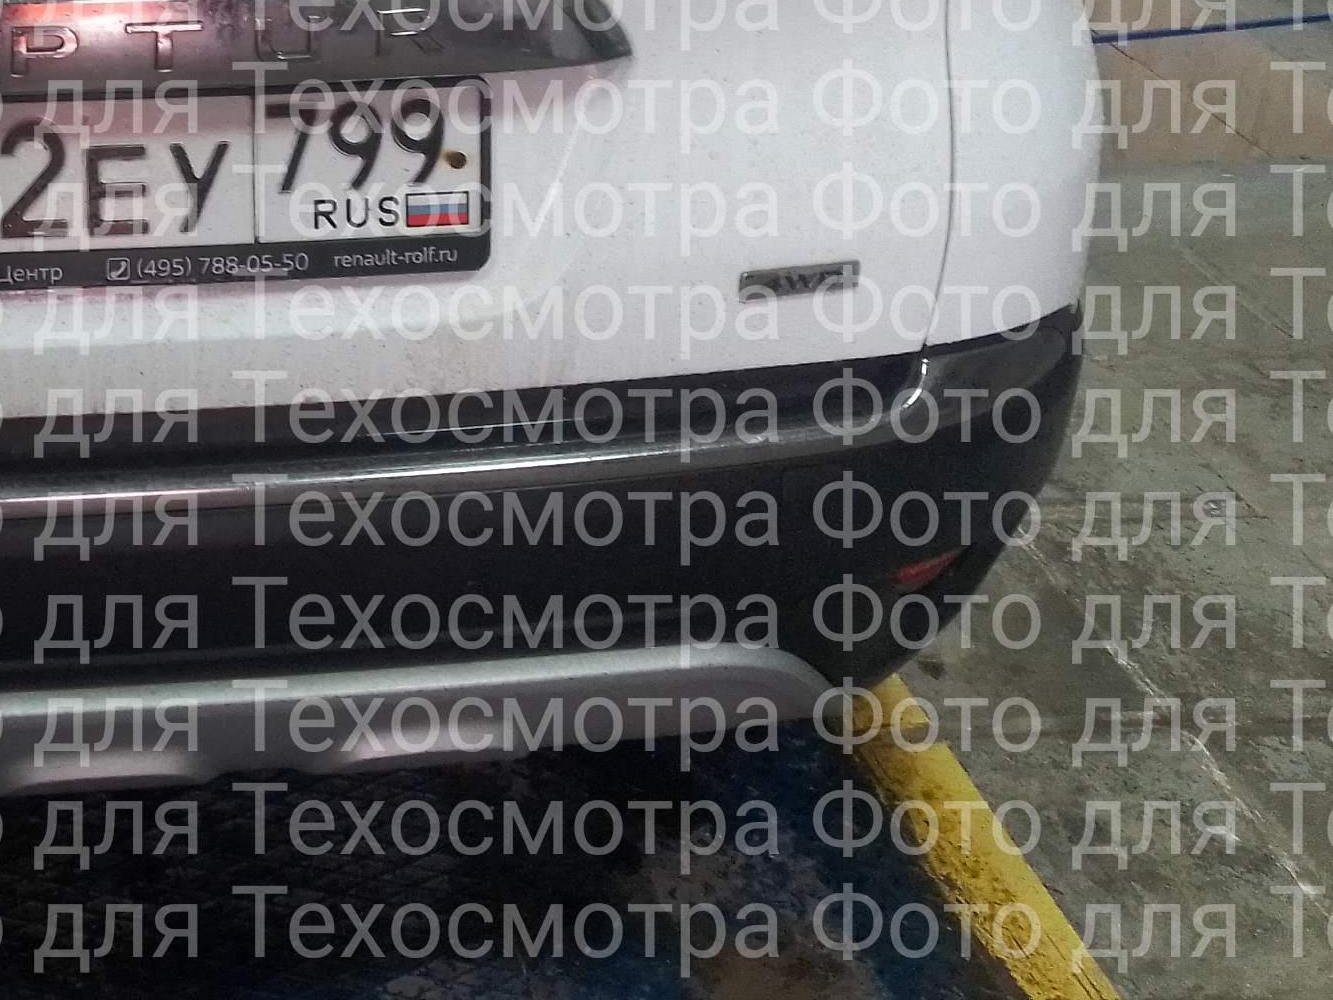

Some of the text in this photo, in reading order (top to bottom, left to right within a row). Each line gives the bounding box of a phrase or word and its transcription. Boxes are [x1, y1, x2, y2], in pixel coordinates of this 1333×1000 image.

[264, 98, 445, 193] 799
[314, 196, 400, 230] RUS
[137, 252, 309, 279] (495) 788-05-50
[333, 246, 459, 269] renault-rolf.ru
